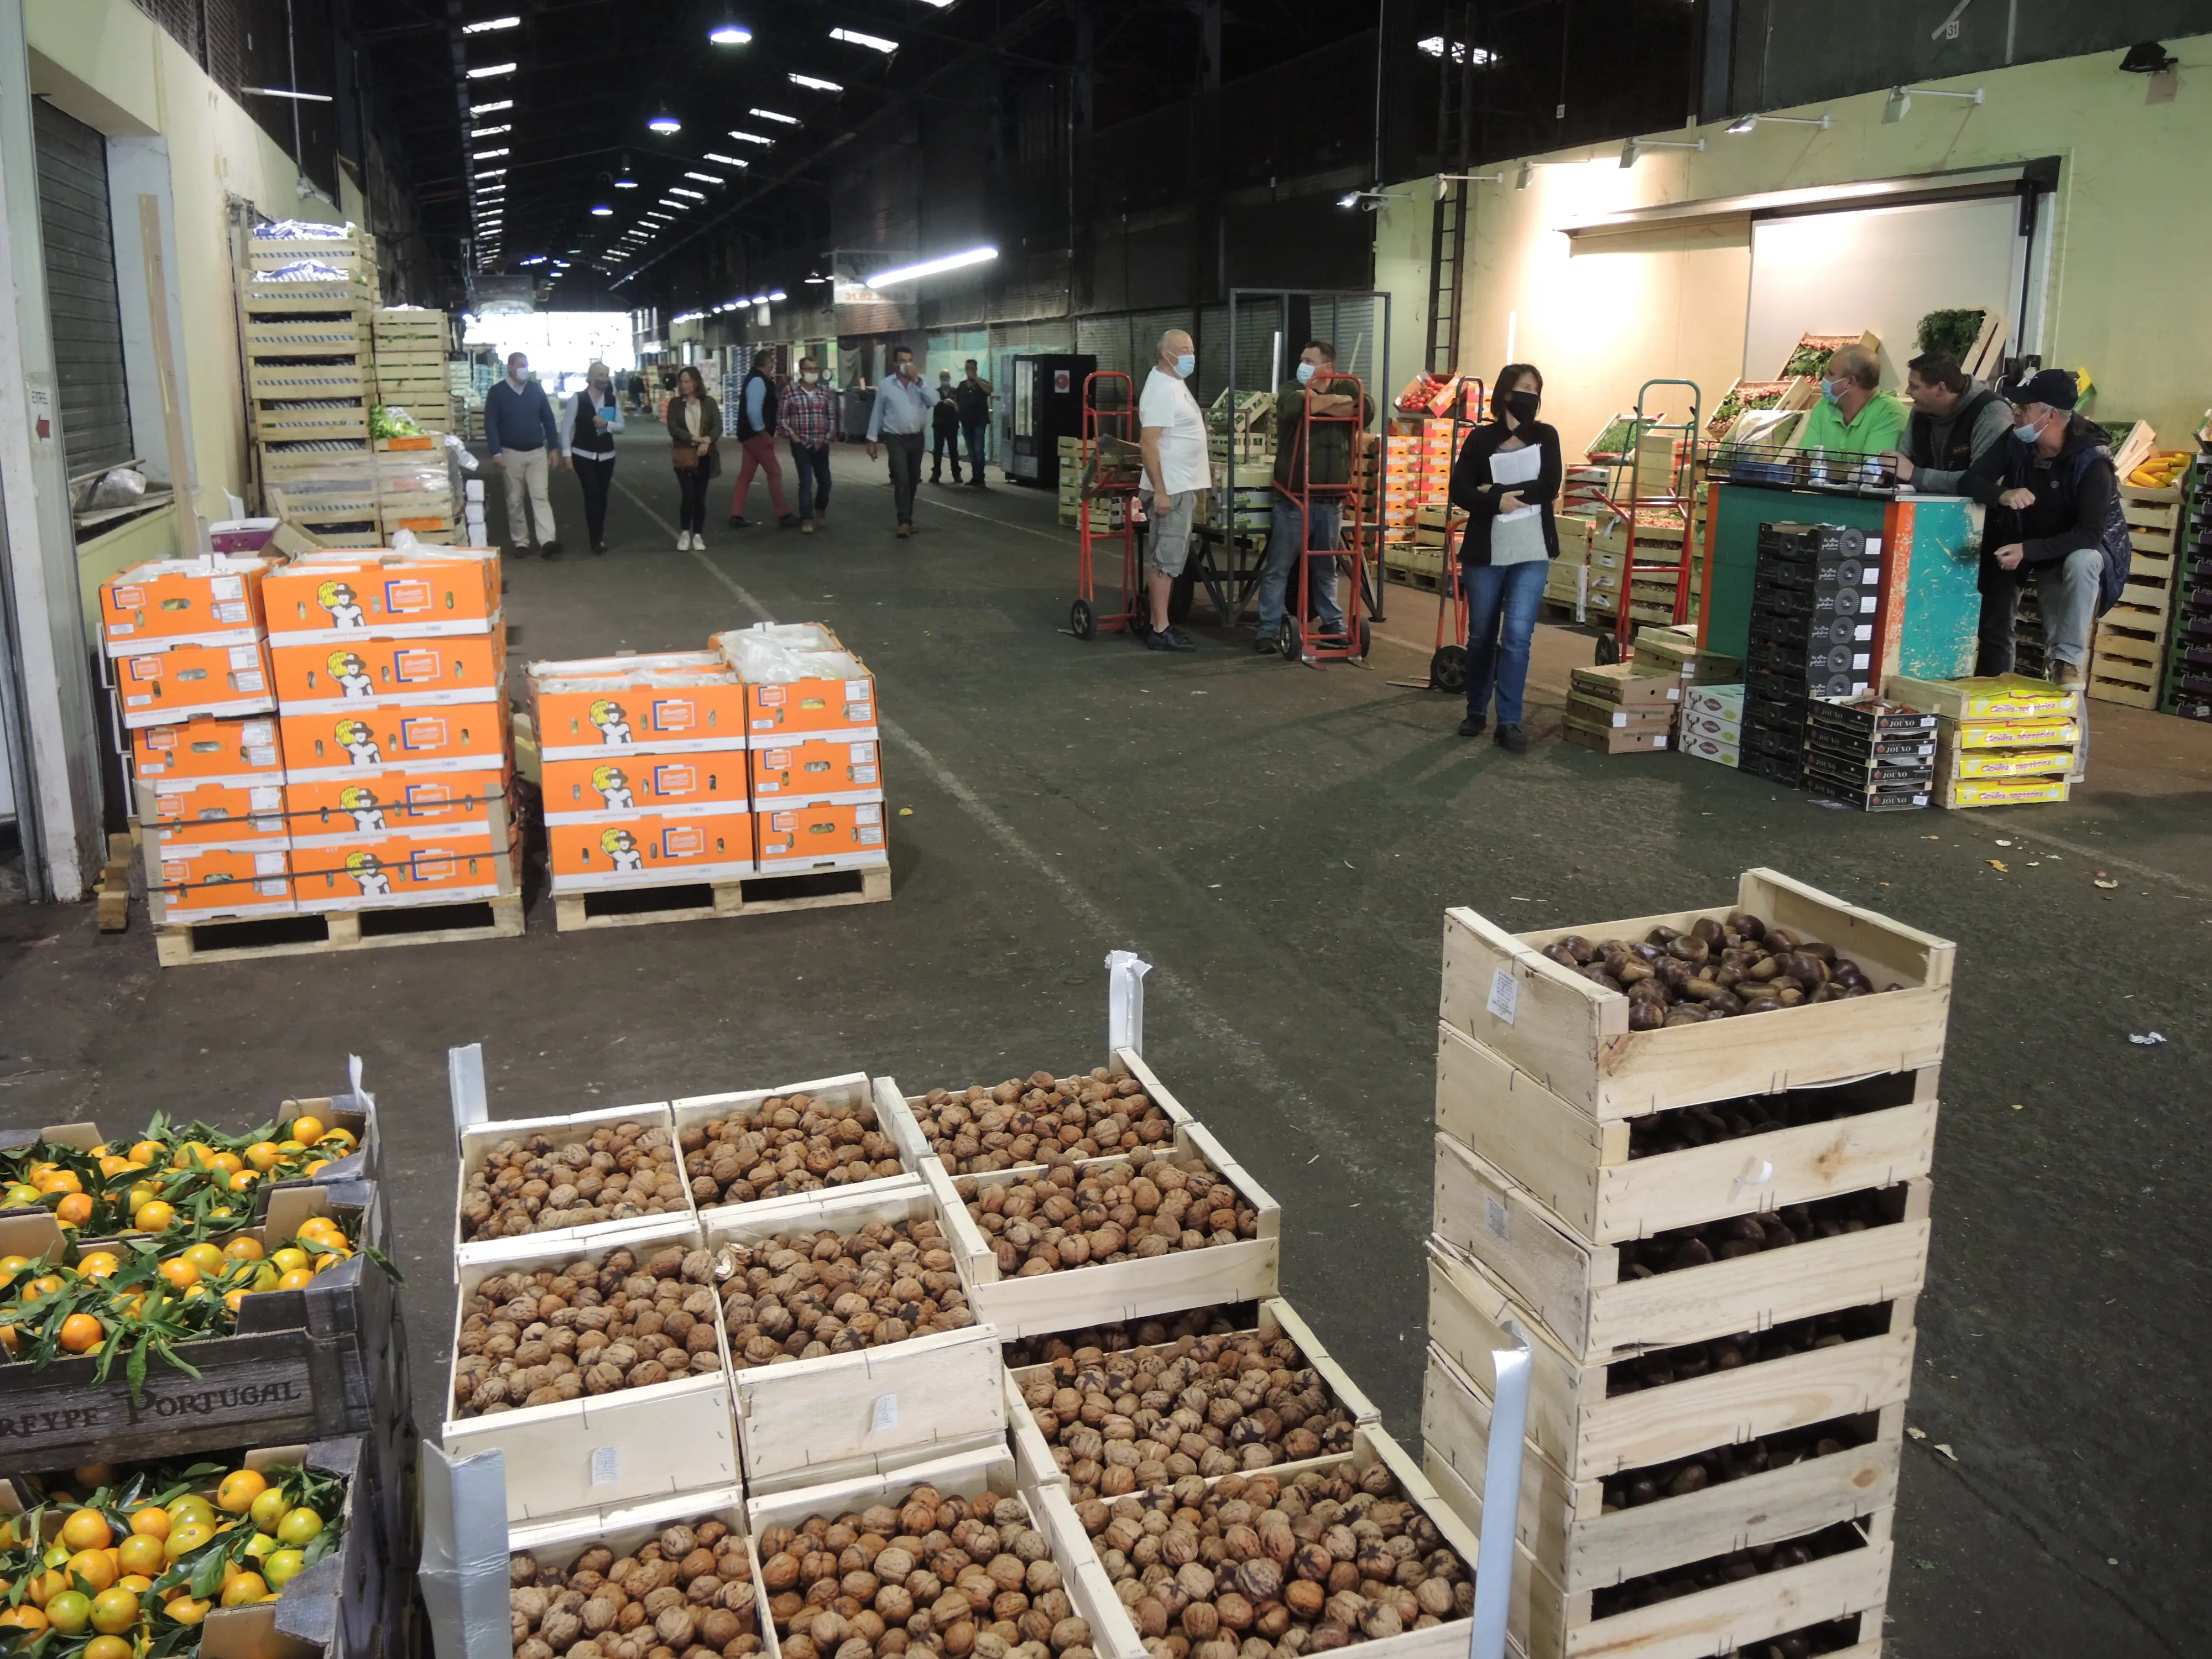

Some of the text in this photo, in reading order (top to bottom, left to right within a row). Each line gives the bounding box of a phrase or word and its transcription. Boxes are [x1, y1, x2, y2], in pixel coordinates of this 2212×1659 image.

[1948, 24, 1957, 36] 31
[1889, 719, 1915, 728] JOUNO
[1882, 771, 1907, 779] JOUNO
